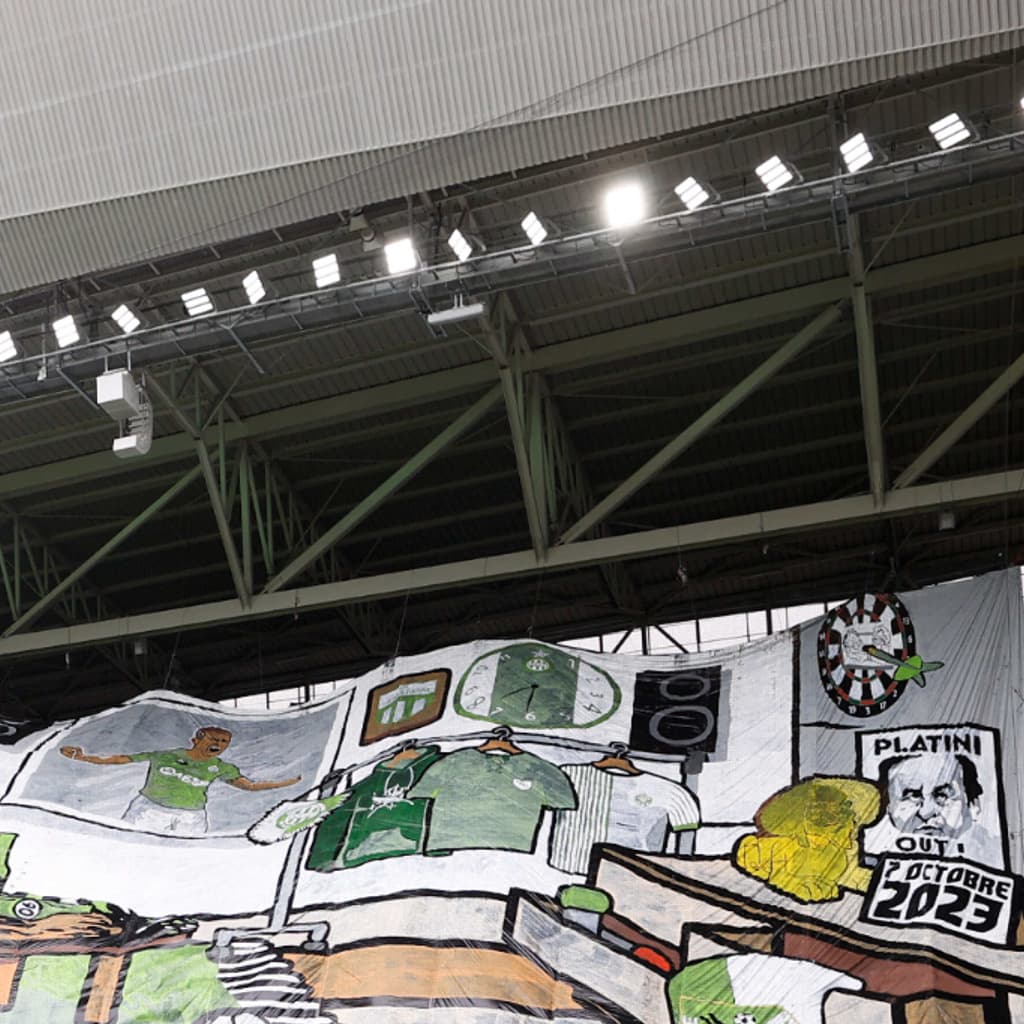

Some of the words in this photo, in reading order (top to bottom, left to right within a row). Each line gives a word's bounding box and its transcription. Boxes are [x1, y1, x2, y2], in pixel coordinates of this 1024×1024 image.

[874, 733, 981, 756] PLATINI
[906, 863, 1011, 900] OCTOBRE
[874, 881, 1004, 933] 2023
